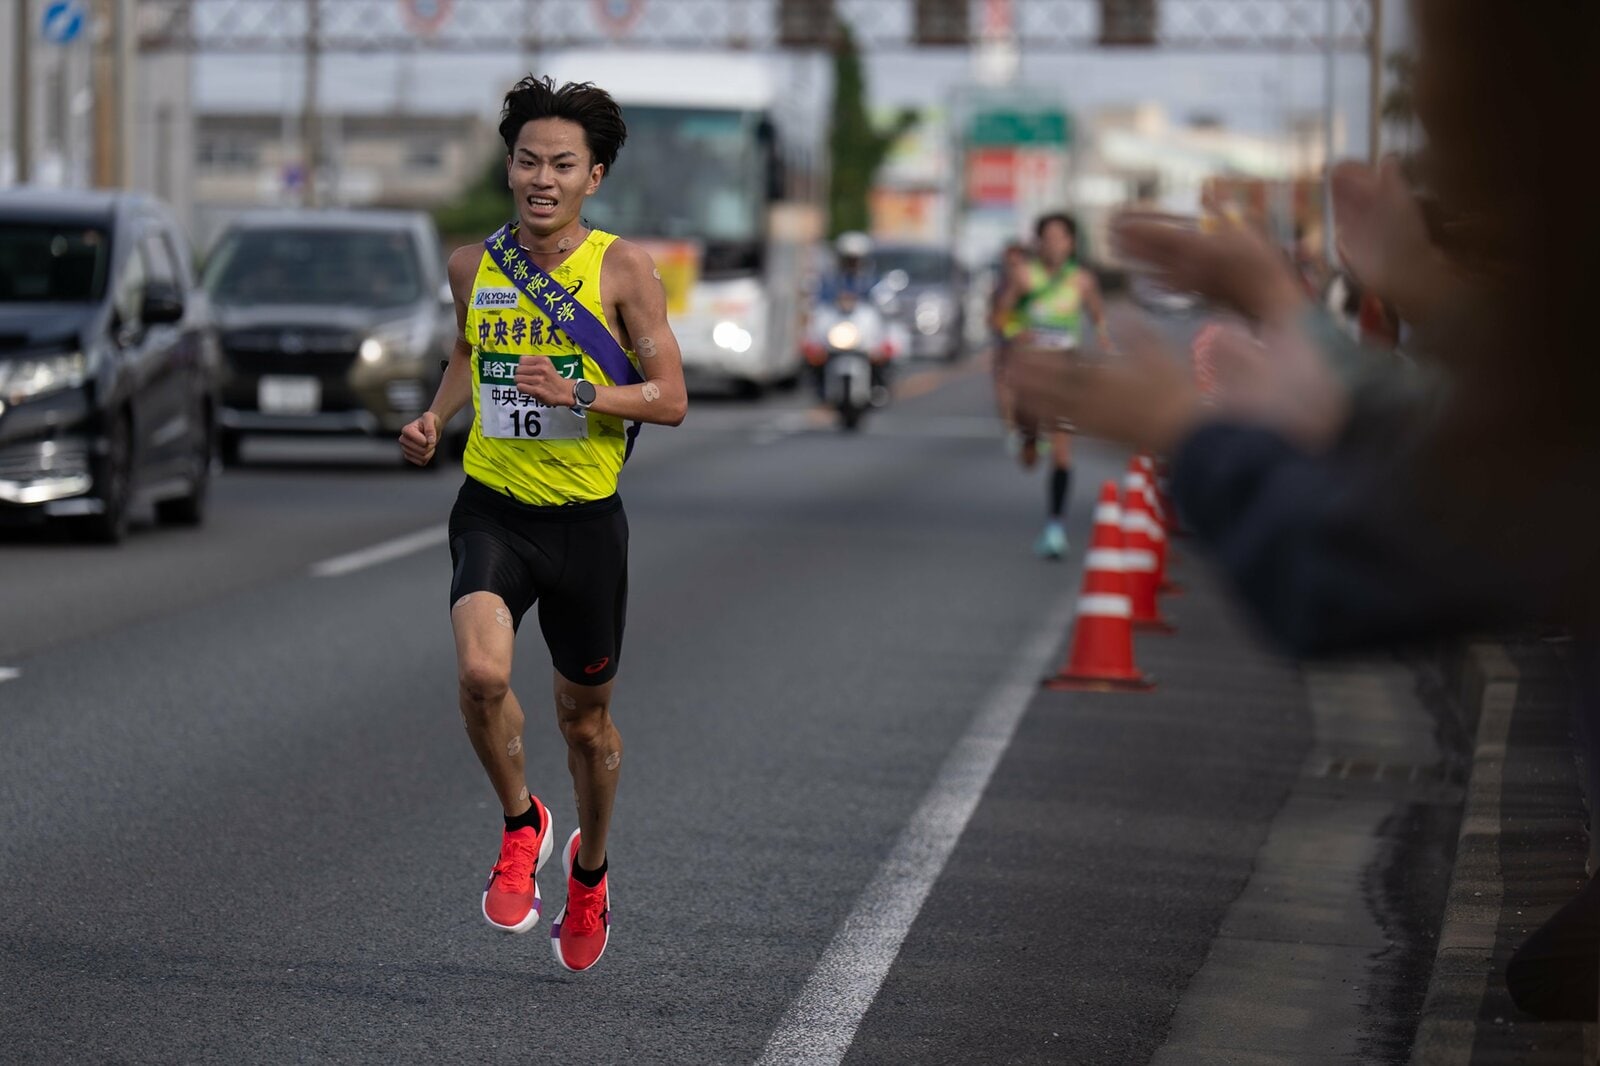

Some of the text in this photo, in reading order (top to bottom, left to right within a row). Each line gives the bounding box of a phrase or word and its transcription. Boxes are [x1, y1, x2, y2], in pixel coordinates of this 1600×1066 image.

[492, 234, 576, 322] 中央学院大学
[478, 317, 576, 347] 中央学院大
[509, 410, 542, 437] 16
